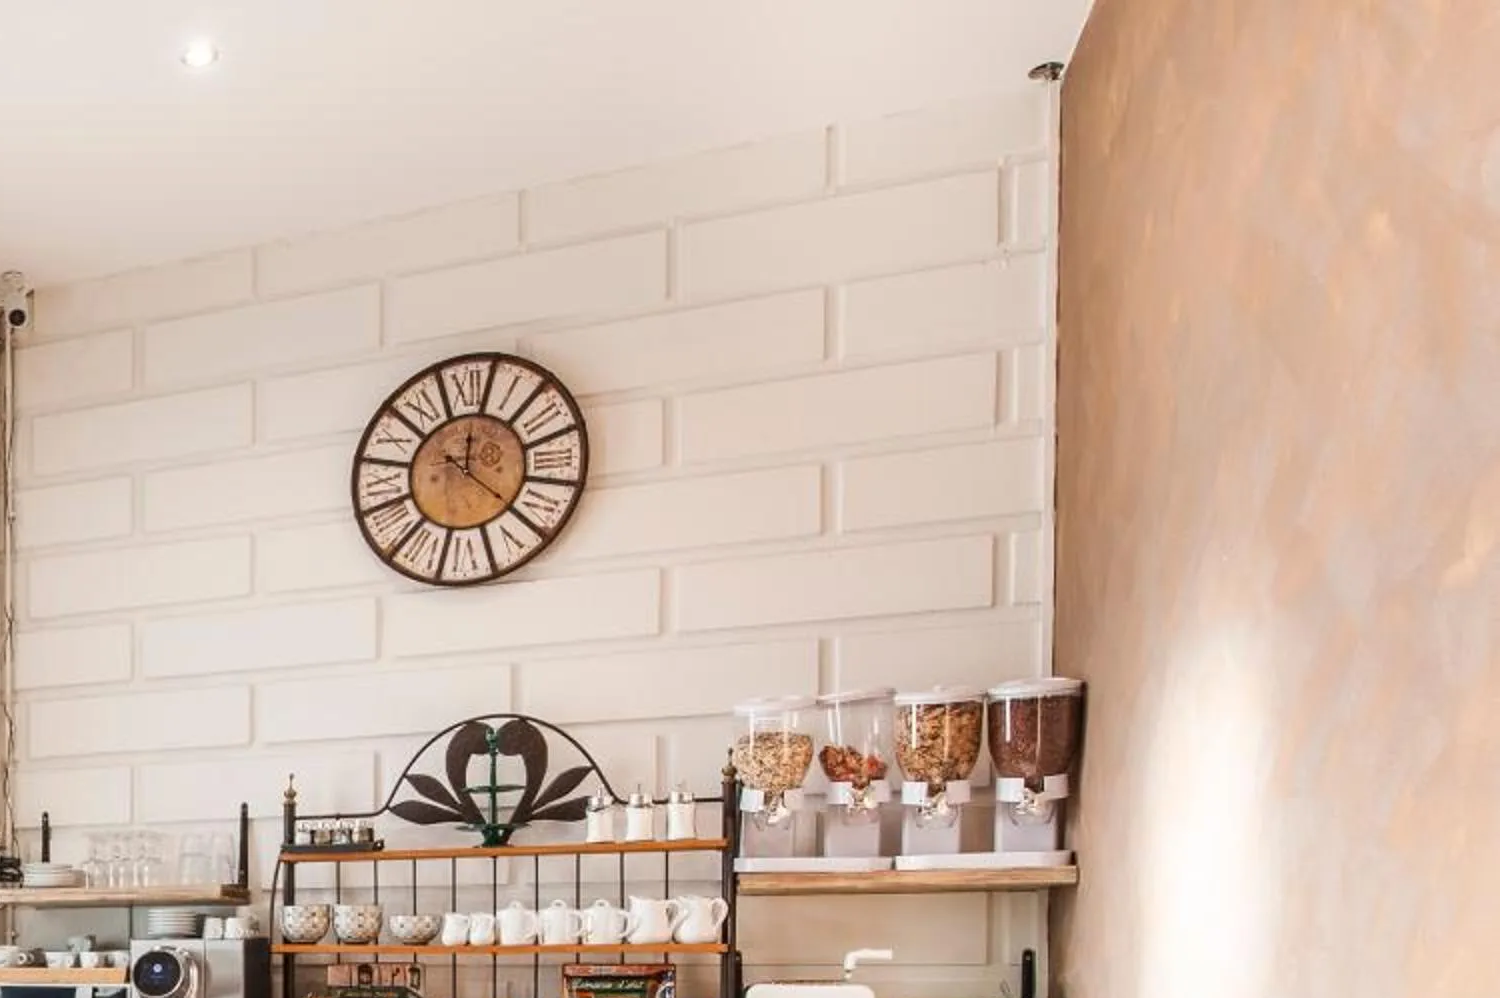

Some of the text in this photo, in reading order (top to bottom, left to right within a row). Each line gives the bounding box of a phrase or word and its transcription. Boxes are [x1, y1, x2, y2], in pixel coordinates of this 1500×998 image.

[451, 369, 482, 410] XII
[376, 428, 412, 455] X
[533, 447, 573, 470] III
